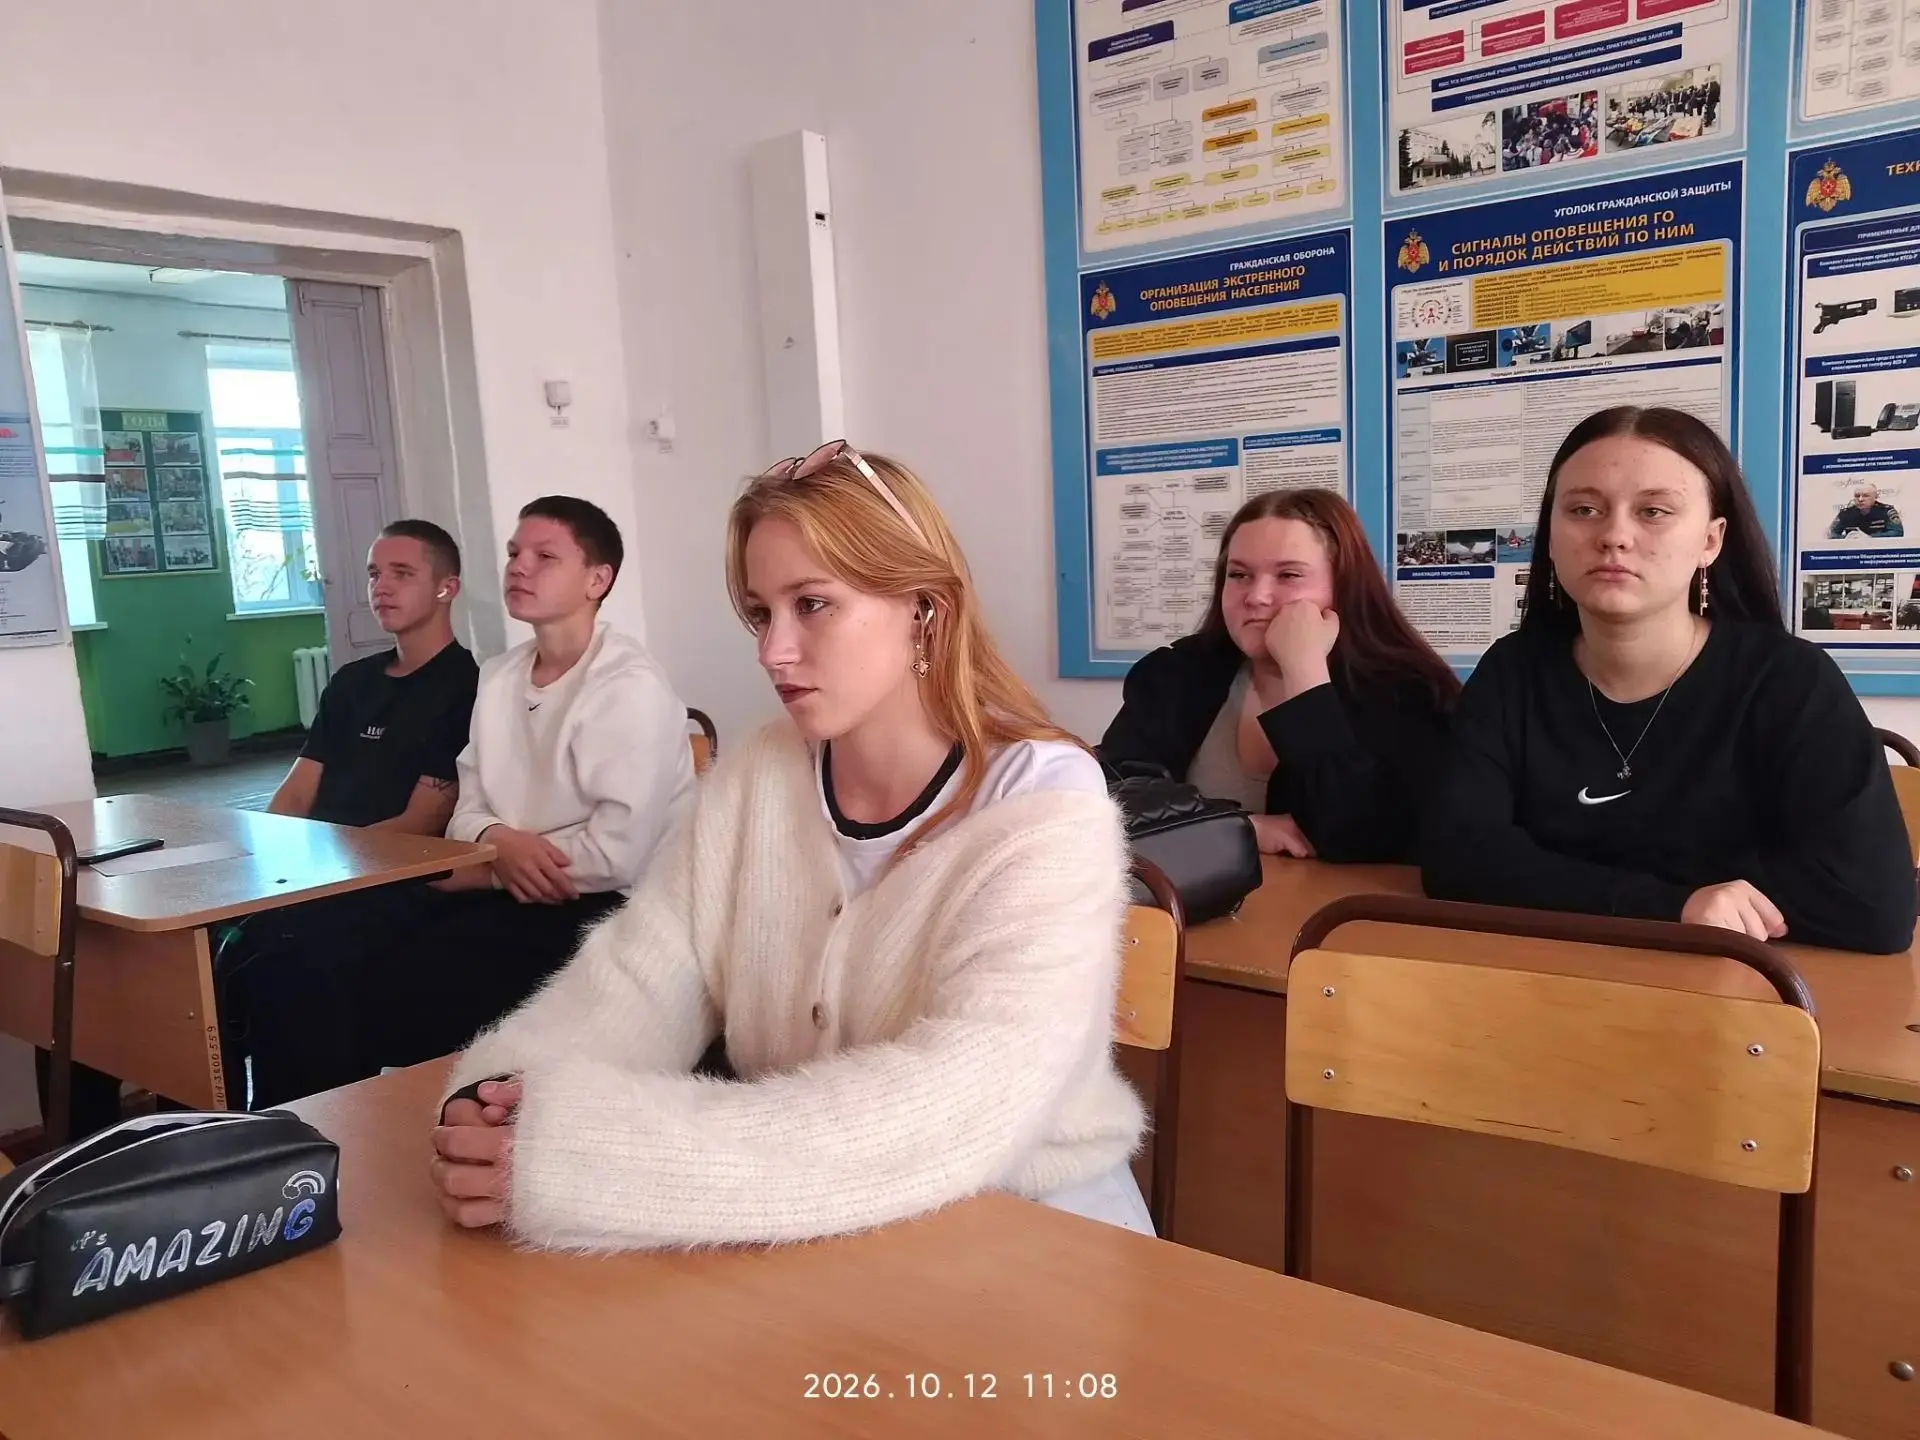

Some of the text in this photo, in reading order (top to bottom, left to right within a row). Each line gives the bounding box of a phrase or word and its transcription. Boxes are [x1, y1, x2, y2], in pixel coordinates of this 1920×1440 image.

[1554, 180, 1731, 219] УГОЛОК ГРАЖДАНСКОЙ ЗАЩИТЫ
[1440, 223, 1694, 273] И ПОРЯДОК ДЕЙСТВИЙ ПО НИМ
[1452, 208, 1674, 257] СИГНАЛЫ ОПОВЕЩЕНИЯ ГО
[1230, 247, 1335, 271] ГРАЖДАНСКАЯ ОБОРОНА
[1140, 265, 1305, 301] ОРГАНИЗАЦИЯ ЭКСТРЕННОГО
[1150, 279, 1299, 312] ОПОВЕЩЕНИЯ НАСЕЛЕНИЯ
[72, 1198, 316, 1297] AMAZING
